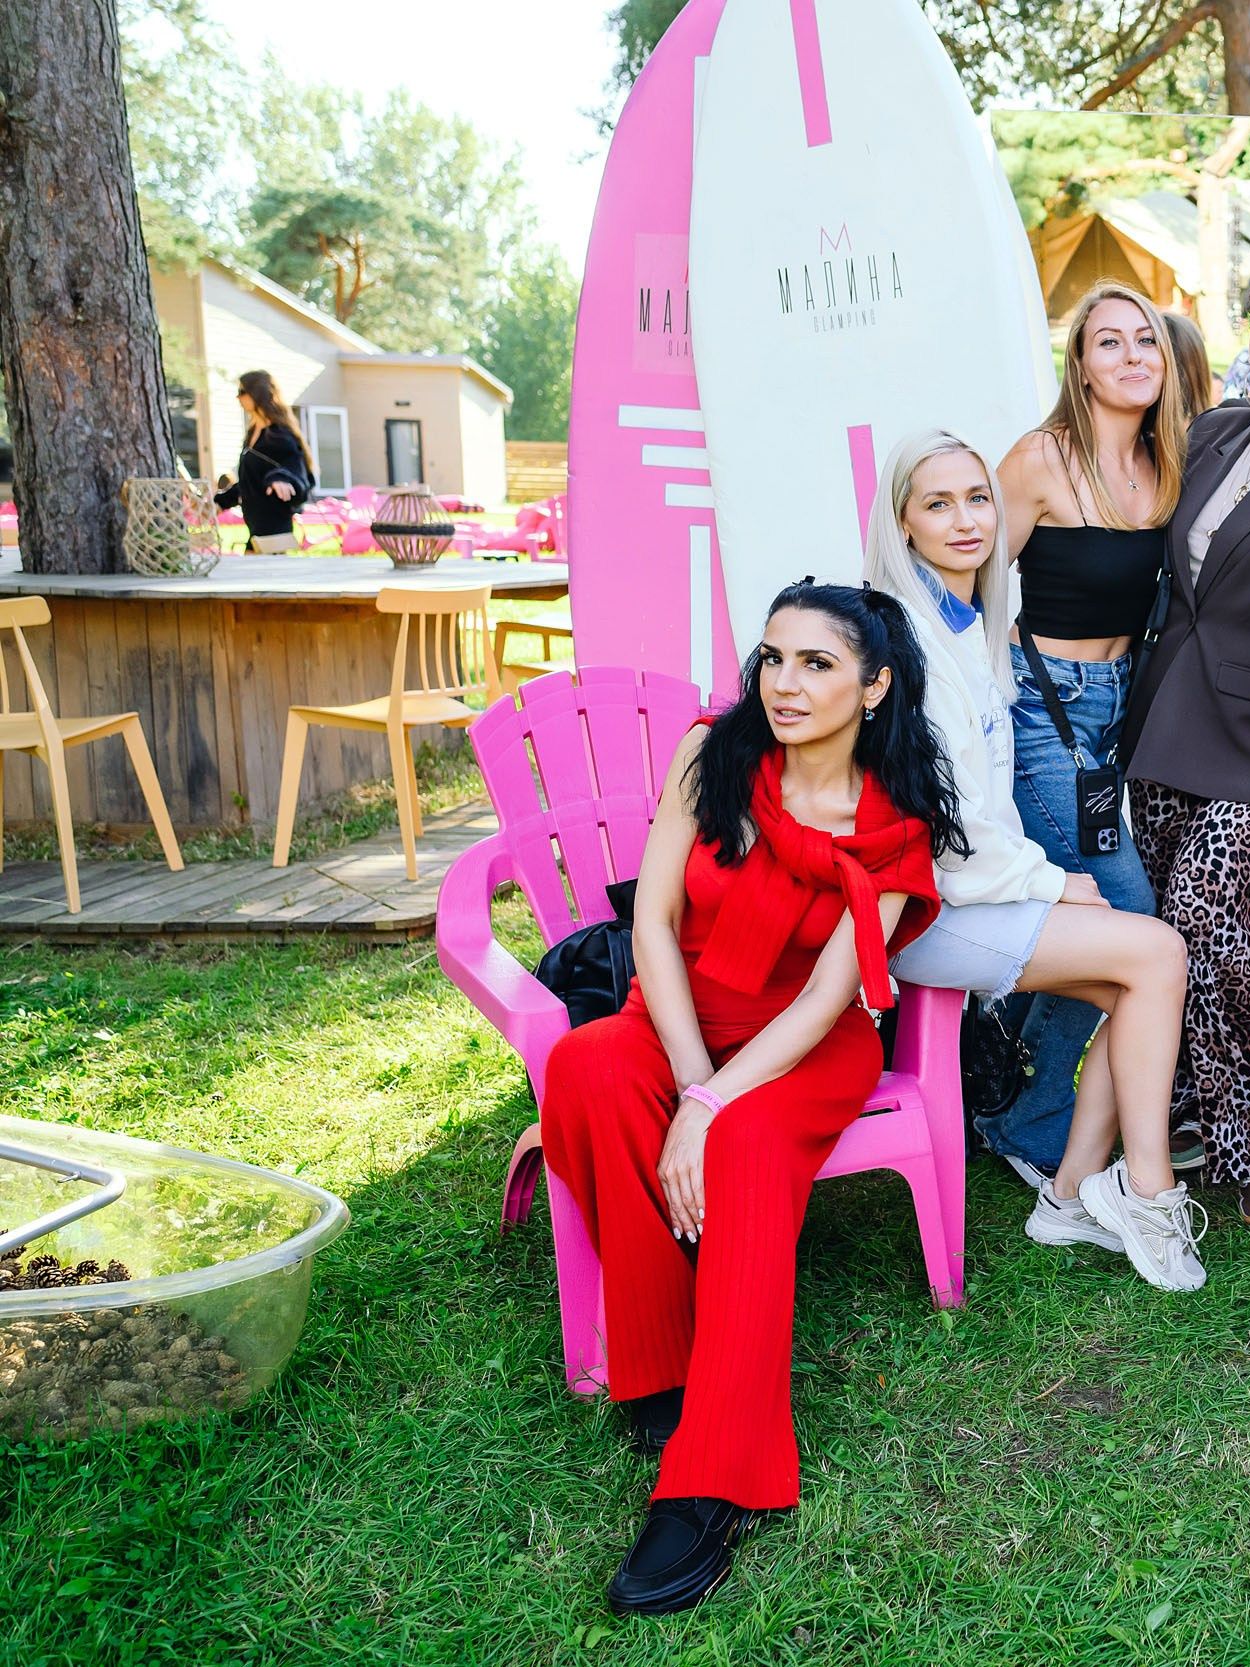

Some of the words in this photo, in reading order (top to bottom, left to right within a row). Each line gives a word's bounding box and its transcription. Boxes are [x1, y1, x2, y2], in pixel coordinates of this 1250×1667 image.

[777, 251, 904, 315] МАЛИНА
[639, 287, 691, 335] МАЛ
[813, 308, 877, 334] GLAMPING
